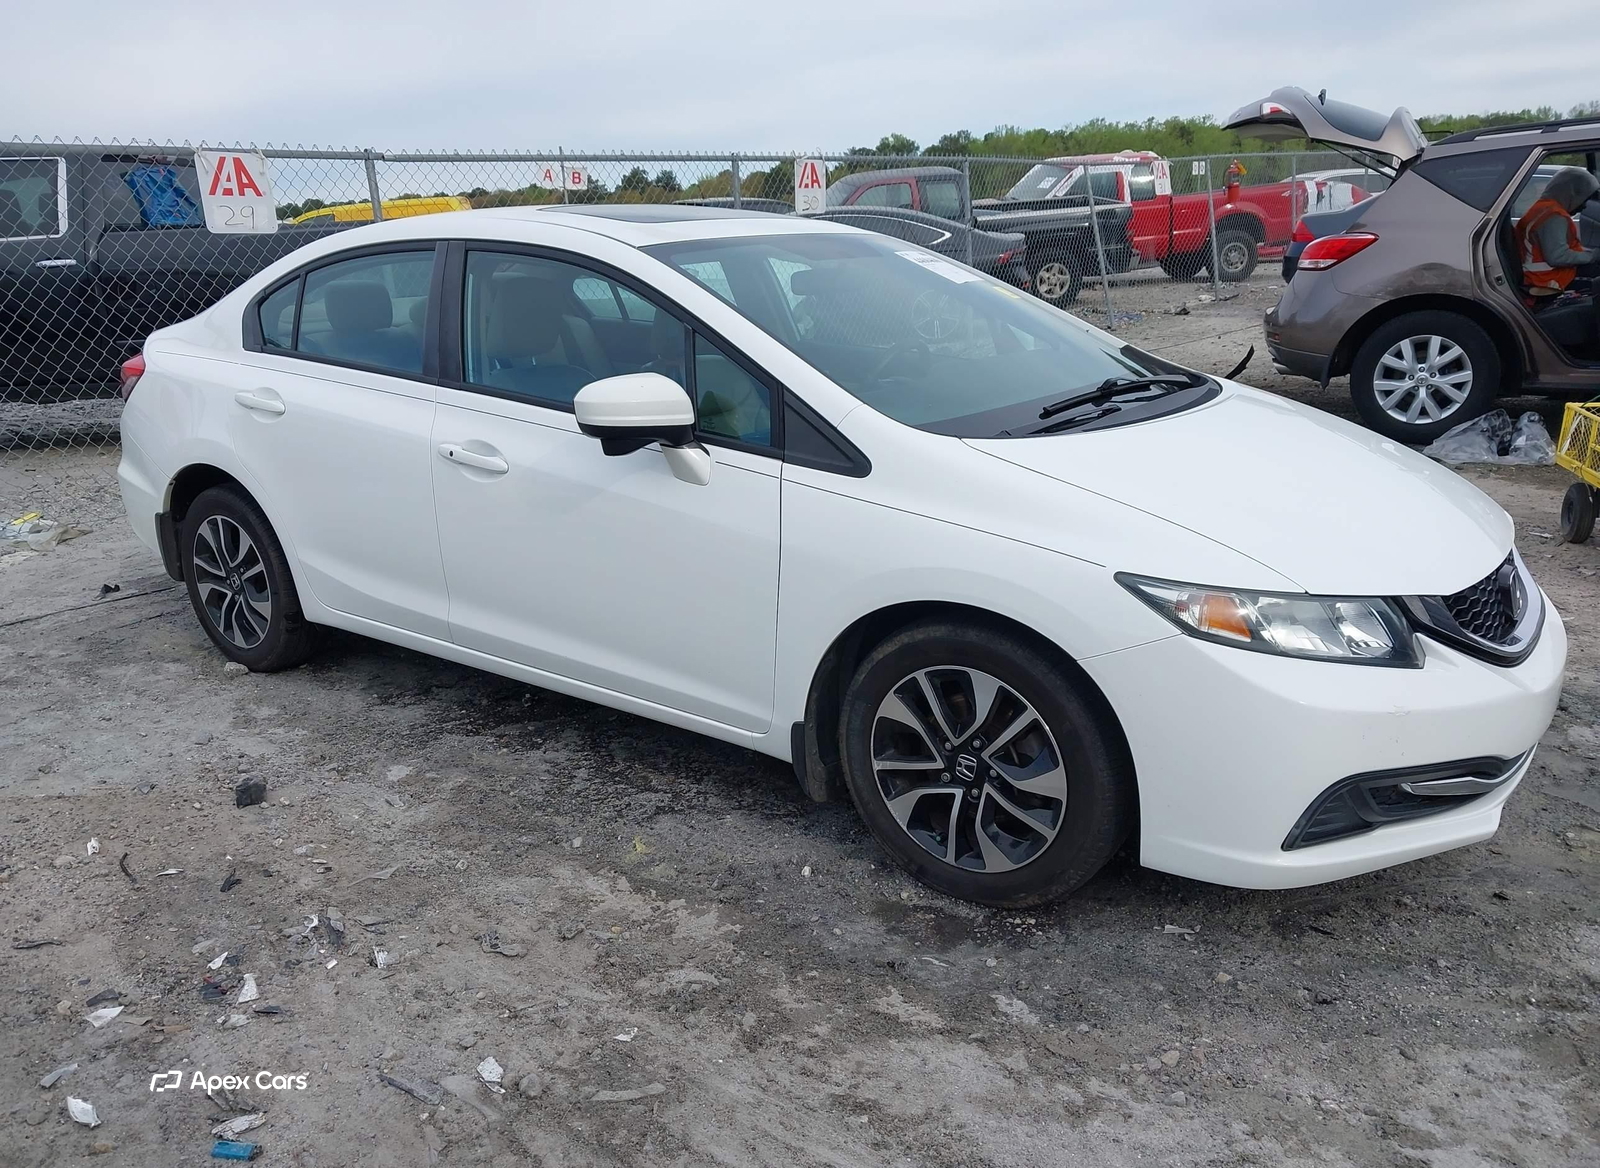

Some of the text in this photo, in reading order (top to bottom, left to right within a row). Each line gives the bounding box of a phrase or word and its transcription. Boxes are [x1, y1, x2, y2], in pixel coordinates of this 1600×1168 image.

[543, 168, 553, 182] A
[572, 171, 582, 185] B
[801, 194, 820, 212] 30
[217, 204, 255, 230] 29
